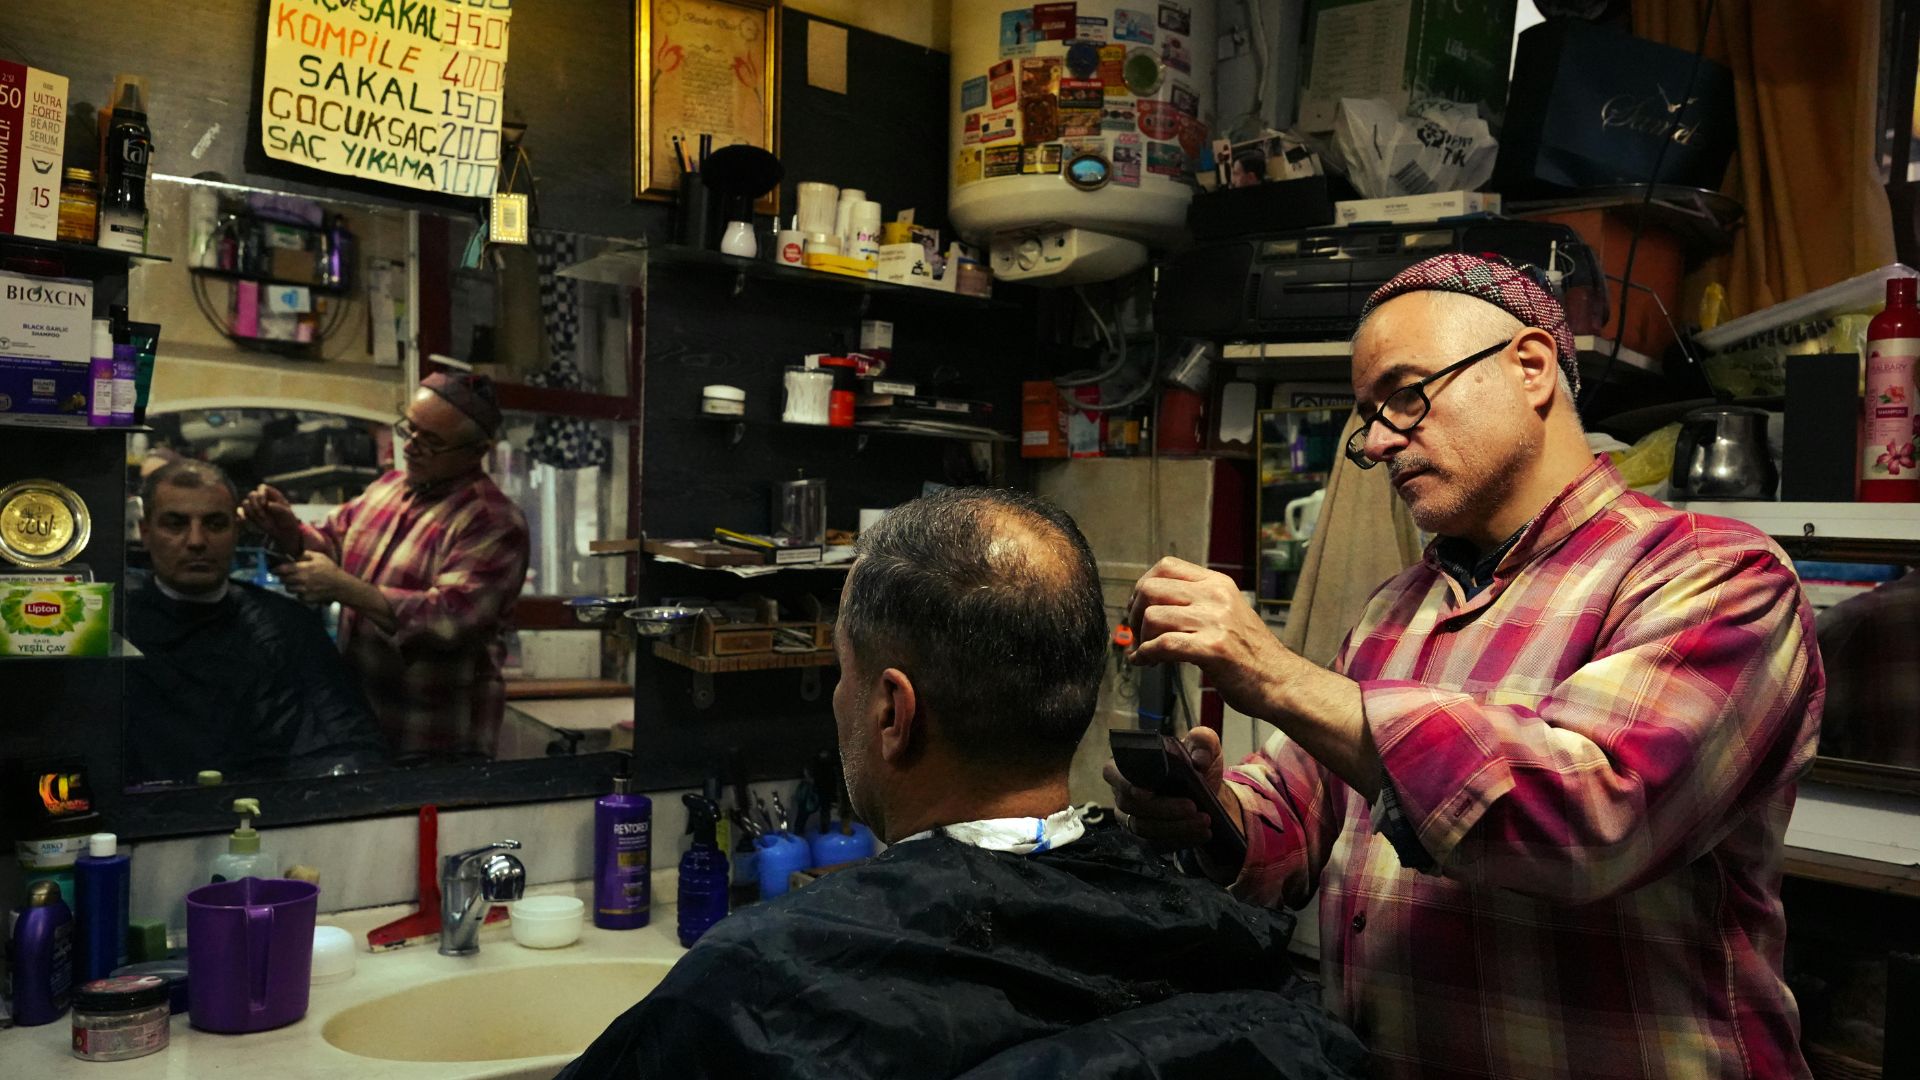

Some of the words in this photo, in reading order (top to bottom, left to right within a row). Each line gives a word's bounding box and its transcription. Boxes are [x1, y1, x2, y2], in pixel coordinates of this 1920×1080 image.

[358, 0, 443, 42] SAKAL
[443, 9, 502, 49] 350
[277, 3, 423, 74] KOMPİLE
[442, 51, 501, 92] 400
[299, 54, 433, 115] SAKAL
[441, 88, 496, 124] 150
[33, 92, 62, 109] ULTRA
[32, 104, 62, 121] FORTE
[30, 118, 60, 134] BEARD
[29, 131, 59, 146] SERUM
[439, 121, 499, 162] 200
[267, 125, 328, 163] SAÇ
[341, 139, 436, 184] YIKAMA
[441, 159, 498, 197] 100
[32, 186, 50, 208] 15
[7, 285, 87, 307] BIOXCIN
[28, 604, 58, 614] Lipton
[18, 643, 46, 653] YEŞİL
[47, 643, 66, 653] ÇAY
